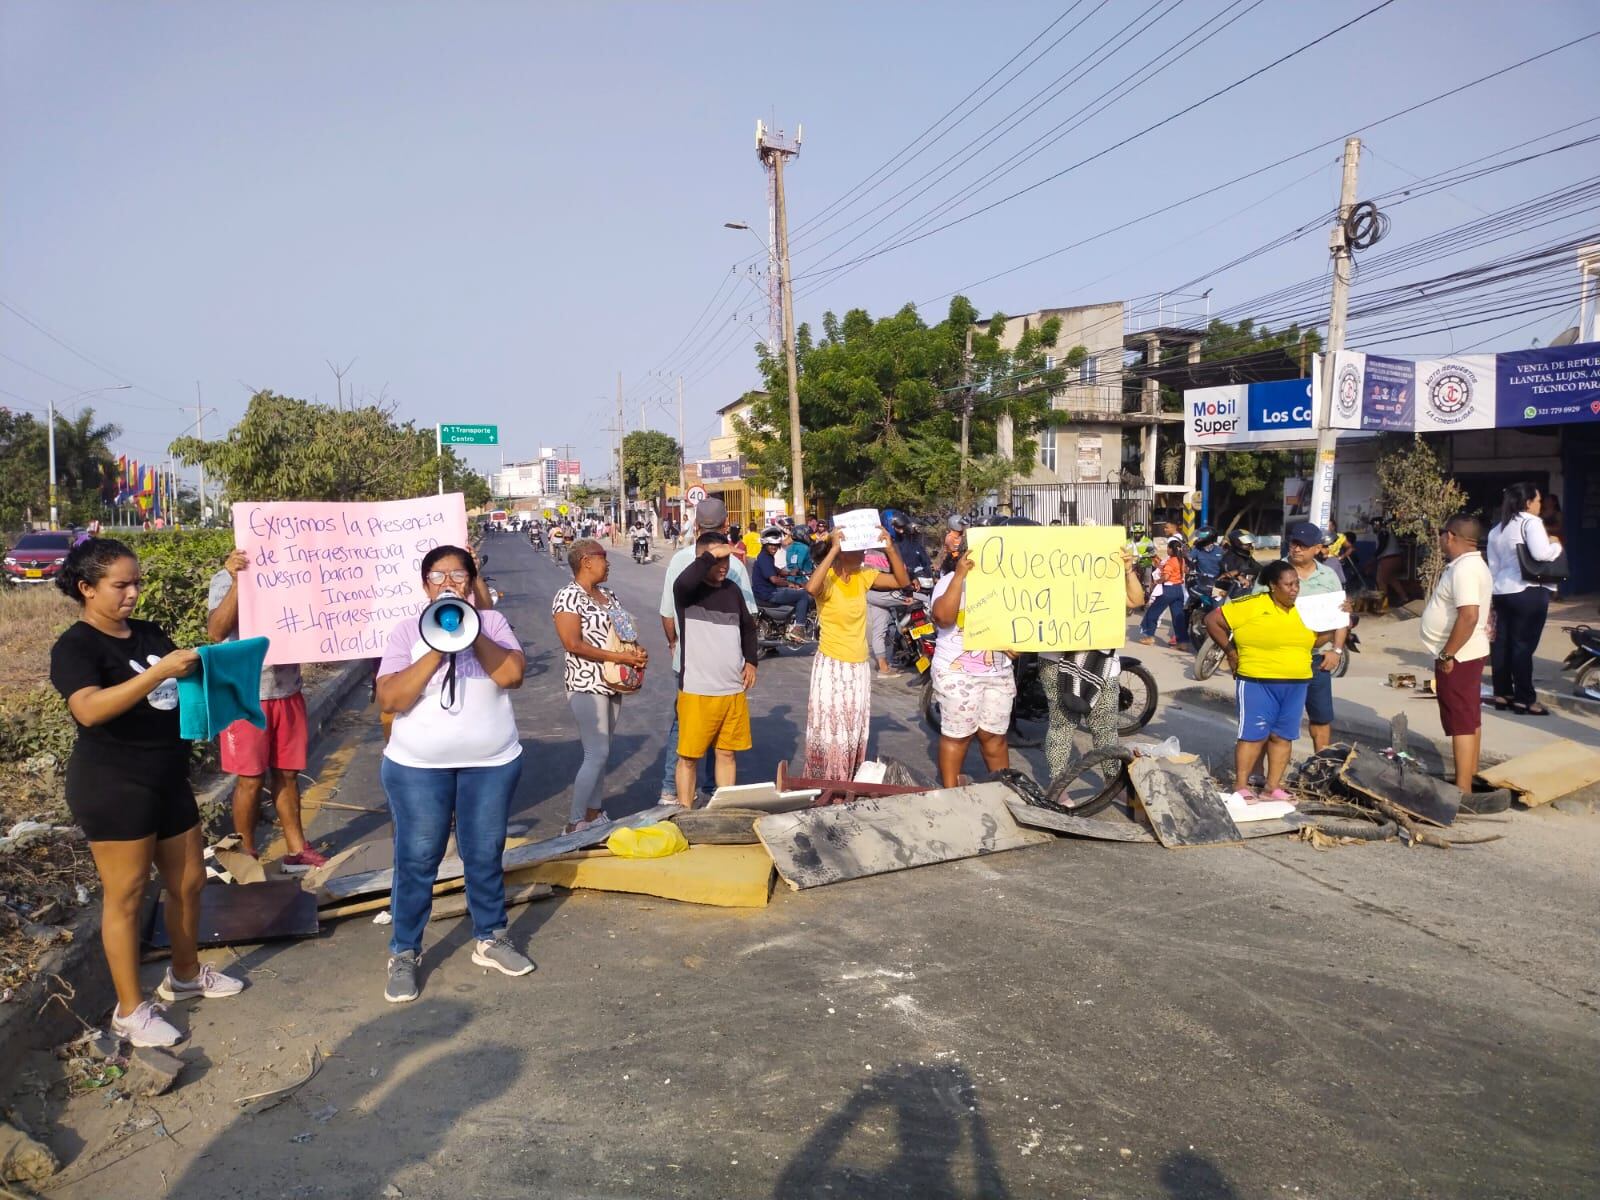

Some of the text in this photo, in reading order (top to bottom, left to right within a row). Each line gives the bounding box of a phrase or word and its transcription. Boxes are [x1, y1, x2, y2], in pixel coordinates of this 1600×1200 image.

[1517, 363, 1549, 373] VENTA
[1551, 361, 1565, 370] DE
[1425, 369, 1440, 386] MOTO
[1532, 383, 1577, 394] TÉCNICO
[1193, 399, 1236, 417] Mobil
[1262, 409, 1289, 423] Los
[456, 426, 491, 434] Transporte
[1194, 418, 1238, 435] Super
[689, 491, 703, 501] 40
[249, 507, 336, 540] Exigimos
[342, 511, 363, 536] la
[255, 545, 280, 567] de
[980, 536, 1121, 580] Queremos
[319, 563, 363, 584] barrio
[375, 562, 401, 582] por
[320, 580, 413, 605] Inconclusas
[1011, 616, 1092, 647] Digna
